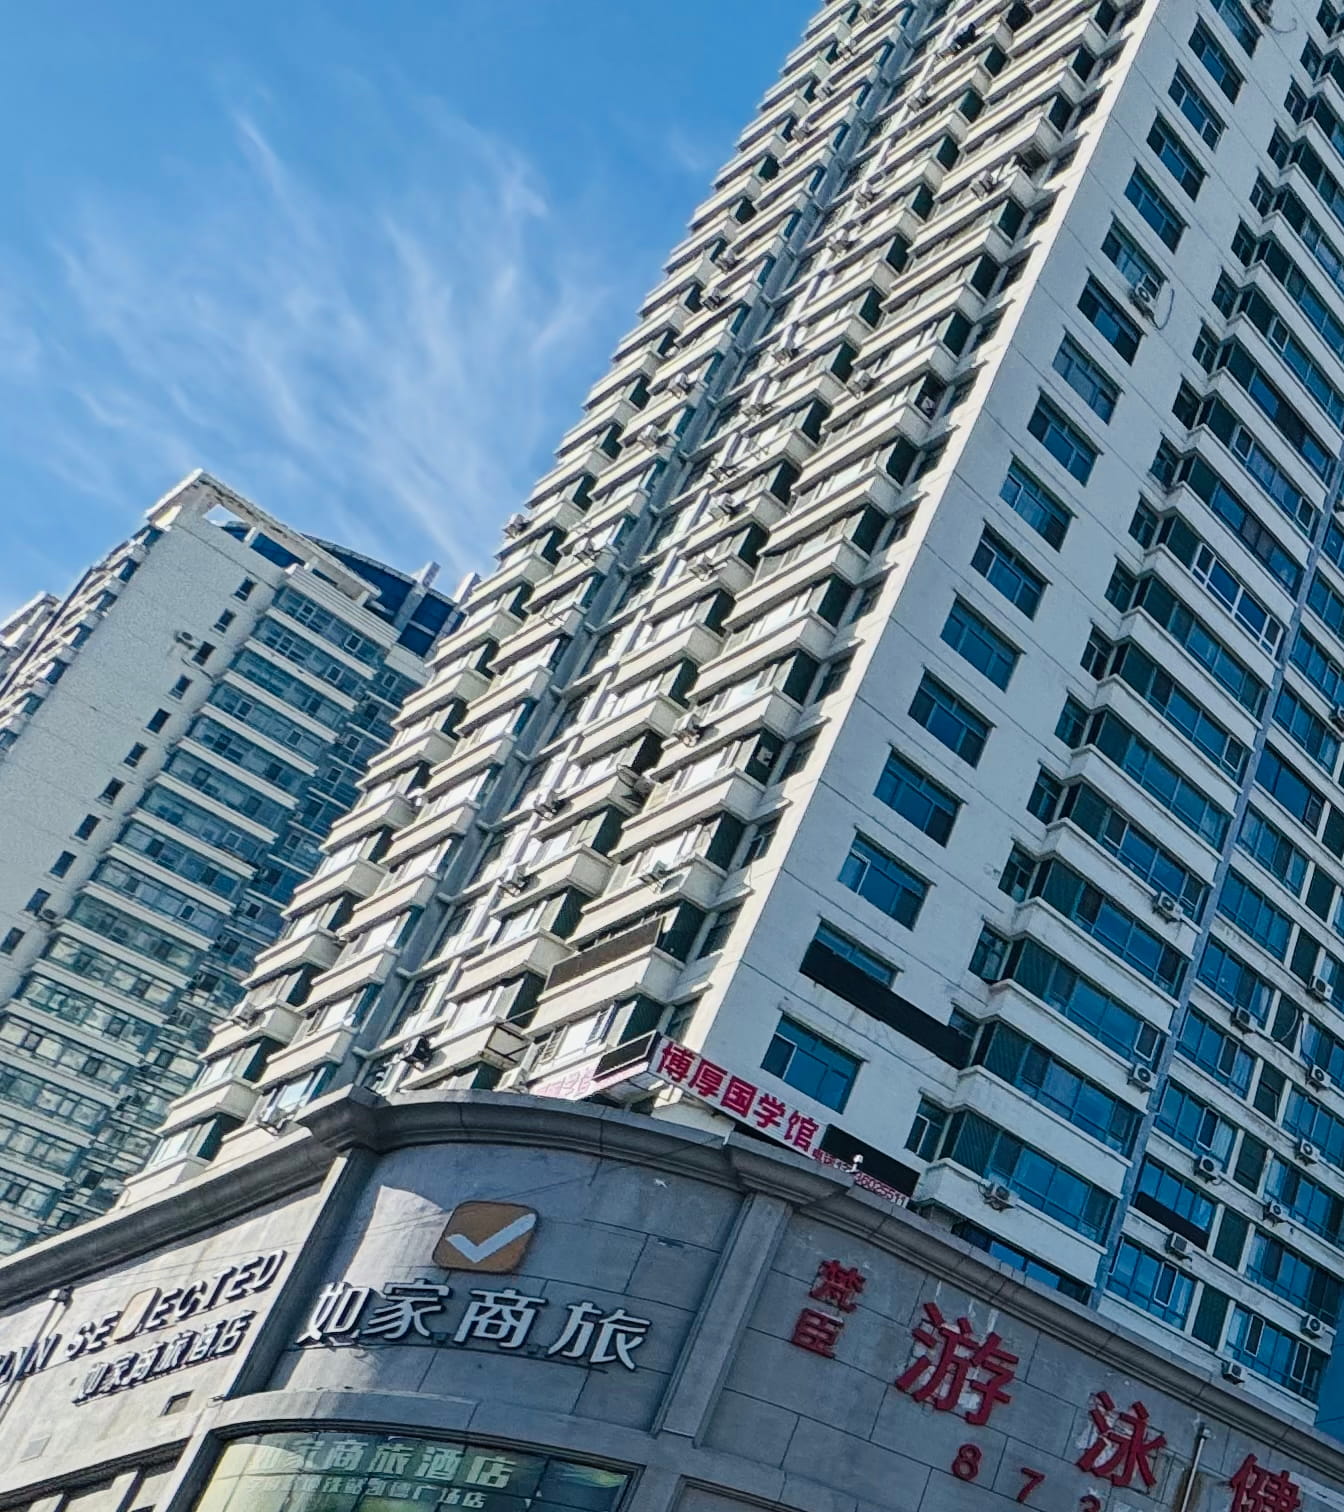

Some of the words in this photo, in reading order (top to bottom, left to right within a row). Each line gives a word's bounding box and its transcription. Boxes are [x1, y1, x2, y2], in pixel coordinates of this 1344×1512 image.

[656, 1040, 820, 1152] 博厚国学馆
[73, 1310, 257, 1406] 如家商旅酒店
[296, 1278, 653, 1371] 如家商旅
